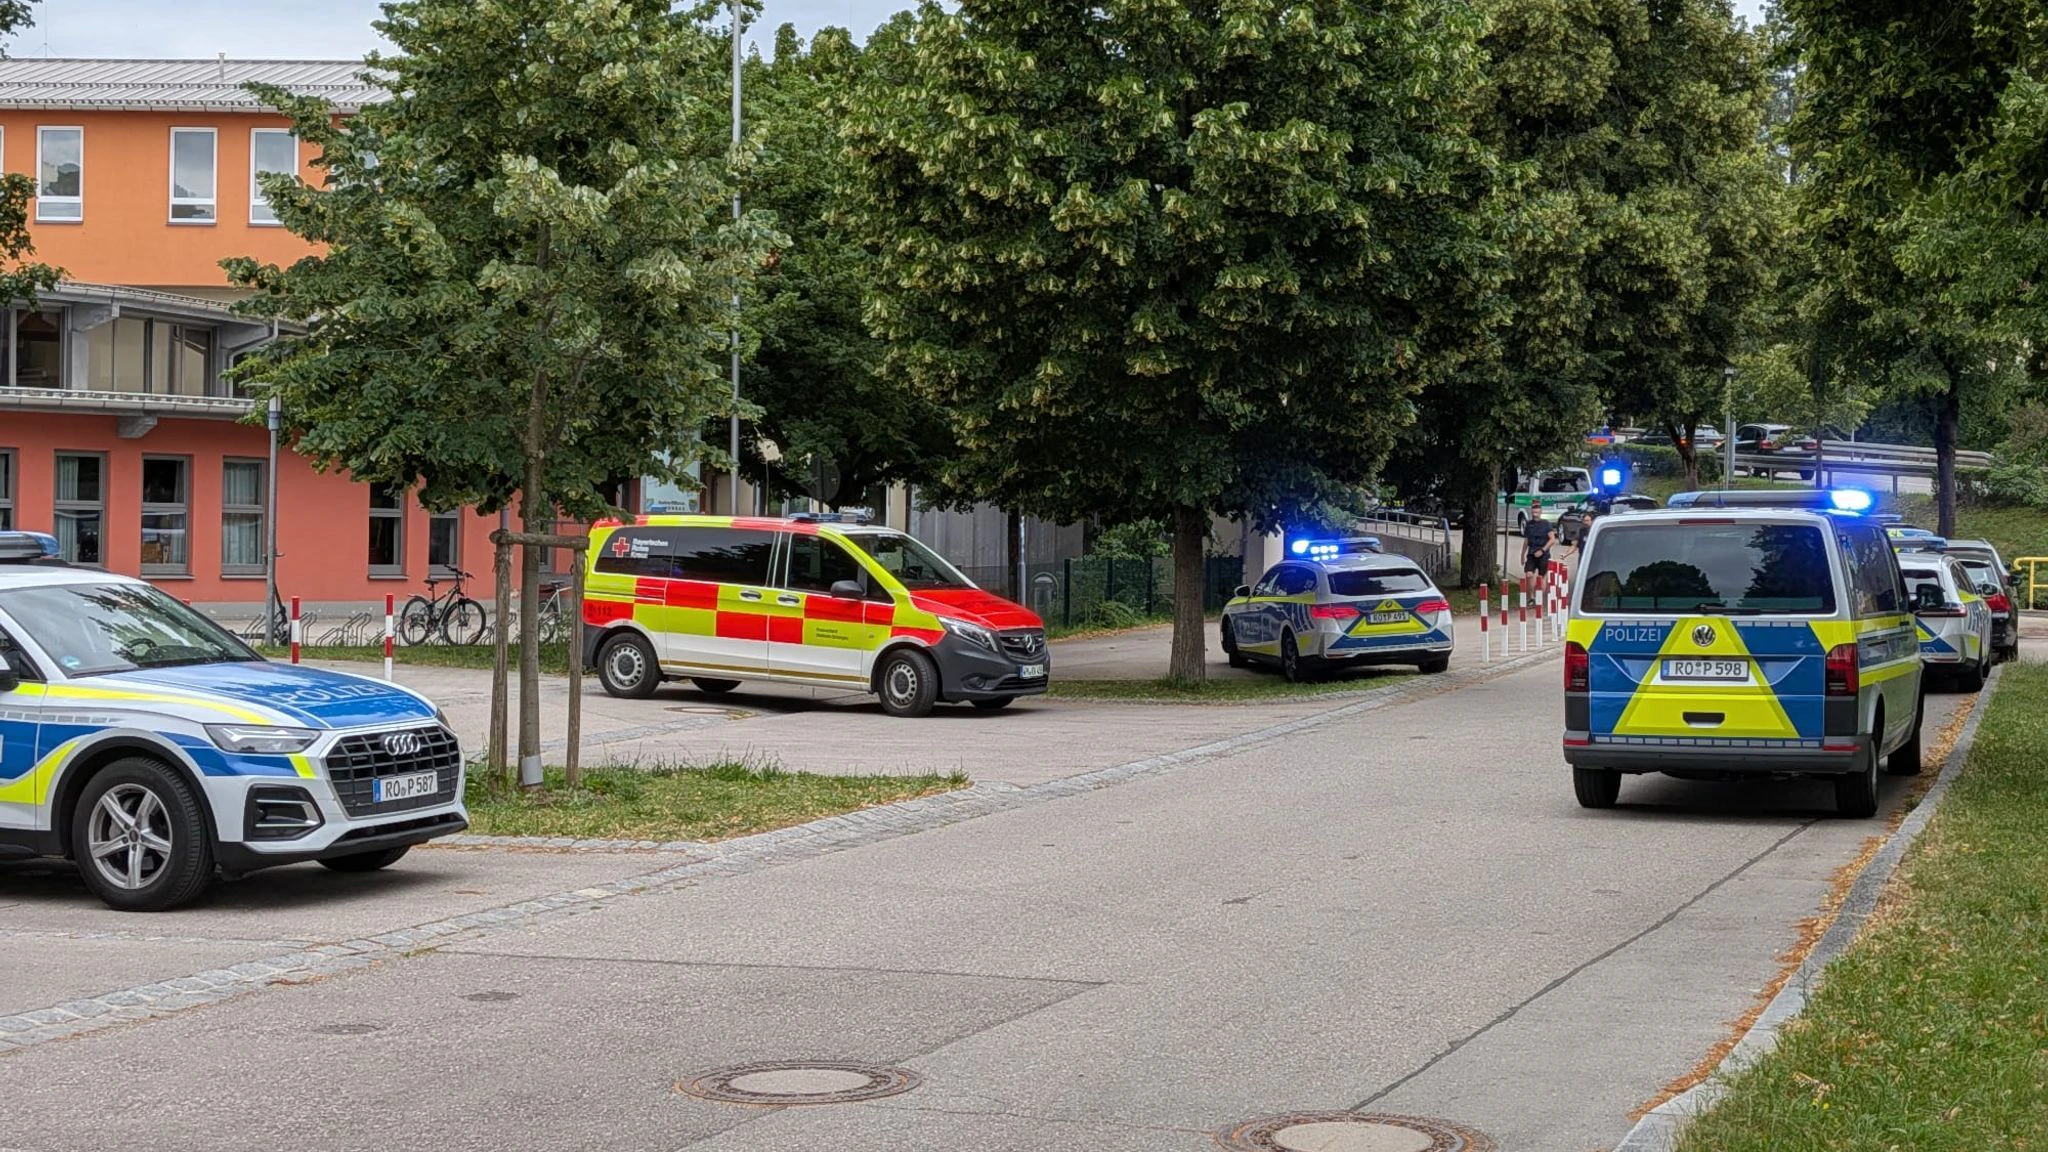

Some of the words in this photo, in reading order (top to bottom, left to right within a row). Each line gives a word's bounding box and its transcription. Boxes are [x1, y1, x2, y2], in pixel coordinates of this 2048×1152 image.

[1605, 628, 1661, 642] POLIZEI
[1674, 662, 1694, 676] RO
[1703, 662, 1713, 676] P
[1715, 662, 1742, 676] 598
[270, 684, 395, 704] POLIZEI
[385, 780, 401, 798] RO
[408, 778, 415, 795] P
[416, 775, 433, 793] 587
